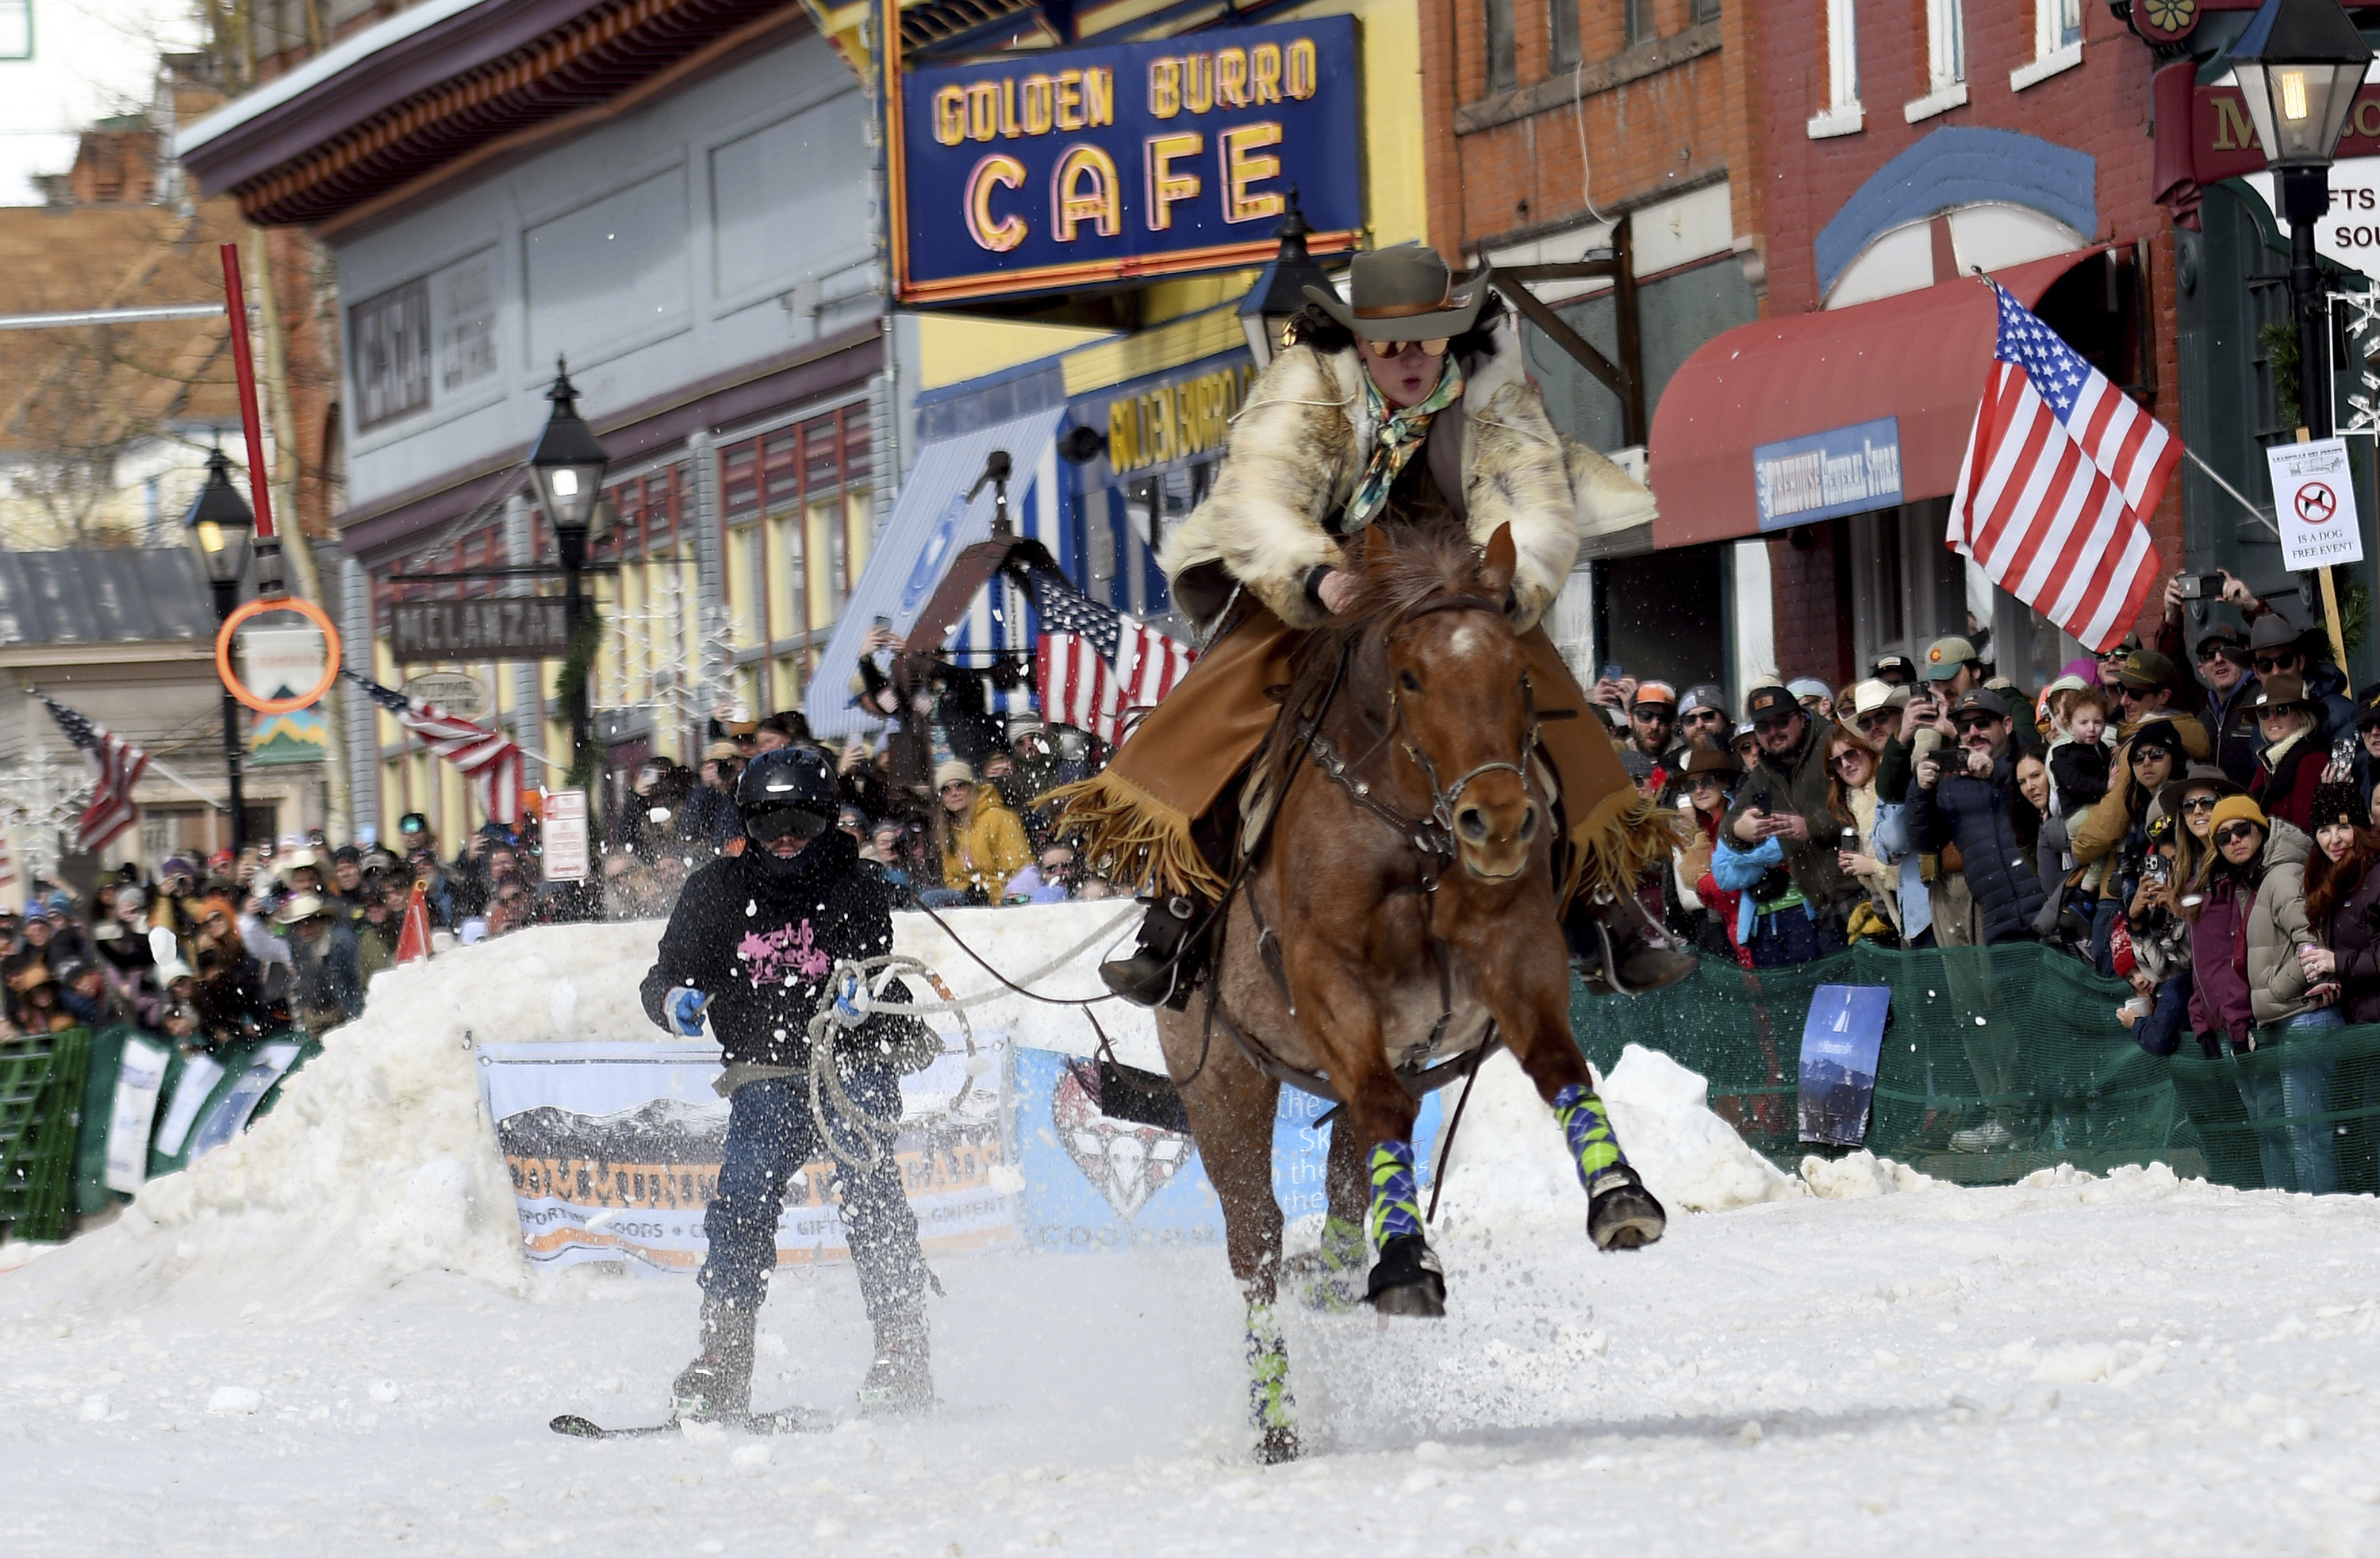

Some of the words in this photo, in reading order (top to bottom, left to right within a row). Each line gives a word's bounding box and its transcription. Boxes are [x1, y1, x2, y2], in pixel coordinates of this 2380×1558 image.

[932, 64, 1114, 147] GOLDEN
[1147, 36, 1317, 119] BURRO
[963, 121, 1287, 253] CAFE
[2292, 547, 2319, 560] FREE
[2320, 541, 2355, 555] EVENT
[2297, 535, 2308, 544] IS
[2309, 533, 2318, 543] A
[2319, 529, 2344, 542] DOG
[396, 601, 569, 654] MELANZAN
[505, 1153, 724, 1211] COMMUNI
[798, 1142, 1002, 1207] TEADS
[517, 1206, 591, 1226] SPORTIN
